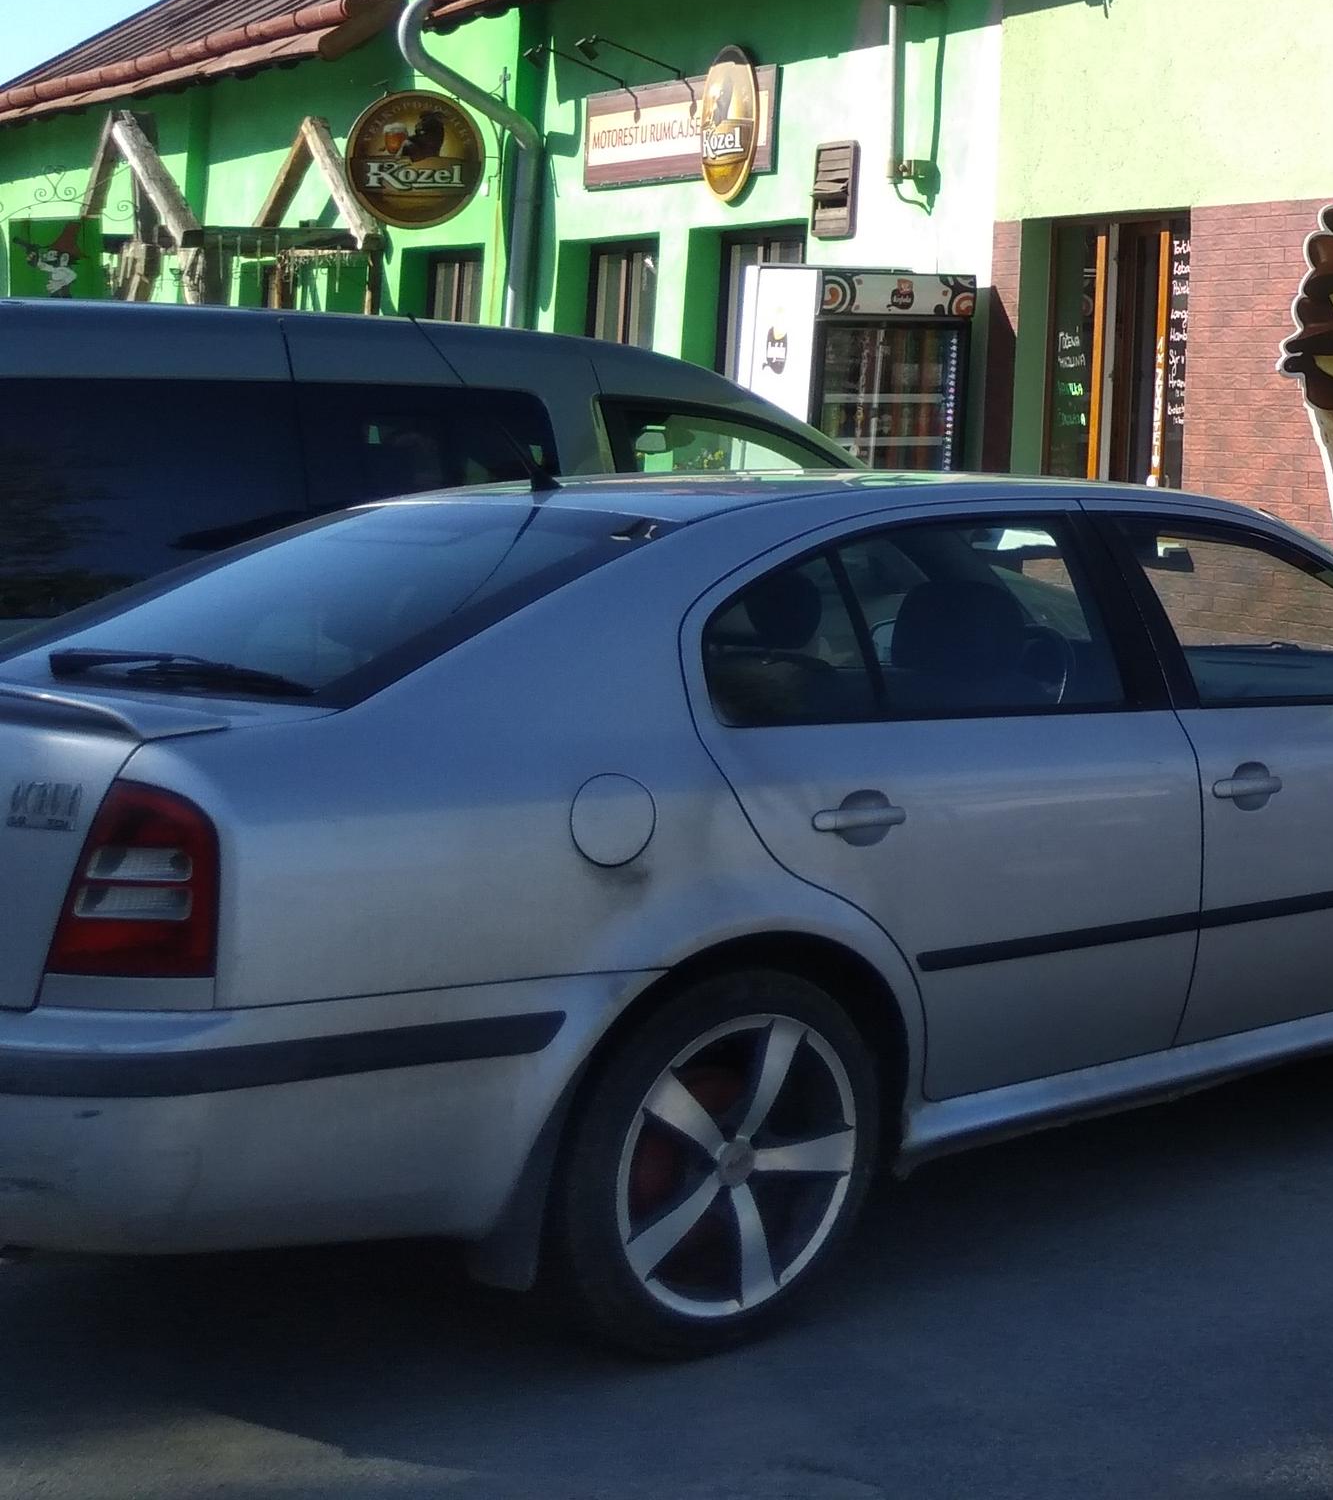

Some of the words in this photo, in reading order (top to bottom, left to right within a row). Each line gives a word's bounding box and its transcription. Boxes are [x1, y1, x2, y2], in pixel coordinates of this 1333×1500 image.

[592, 126, 640, 150] MOTOREST
[640, 124, 648, 143] U
[649, 117, 700, 143] RUMCAJSE
[703, 126, 744, 160] Kozel
[365, 162, 465, 191] Kozel
